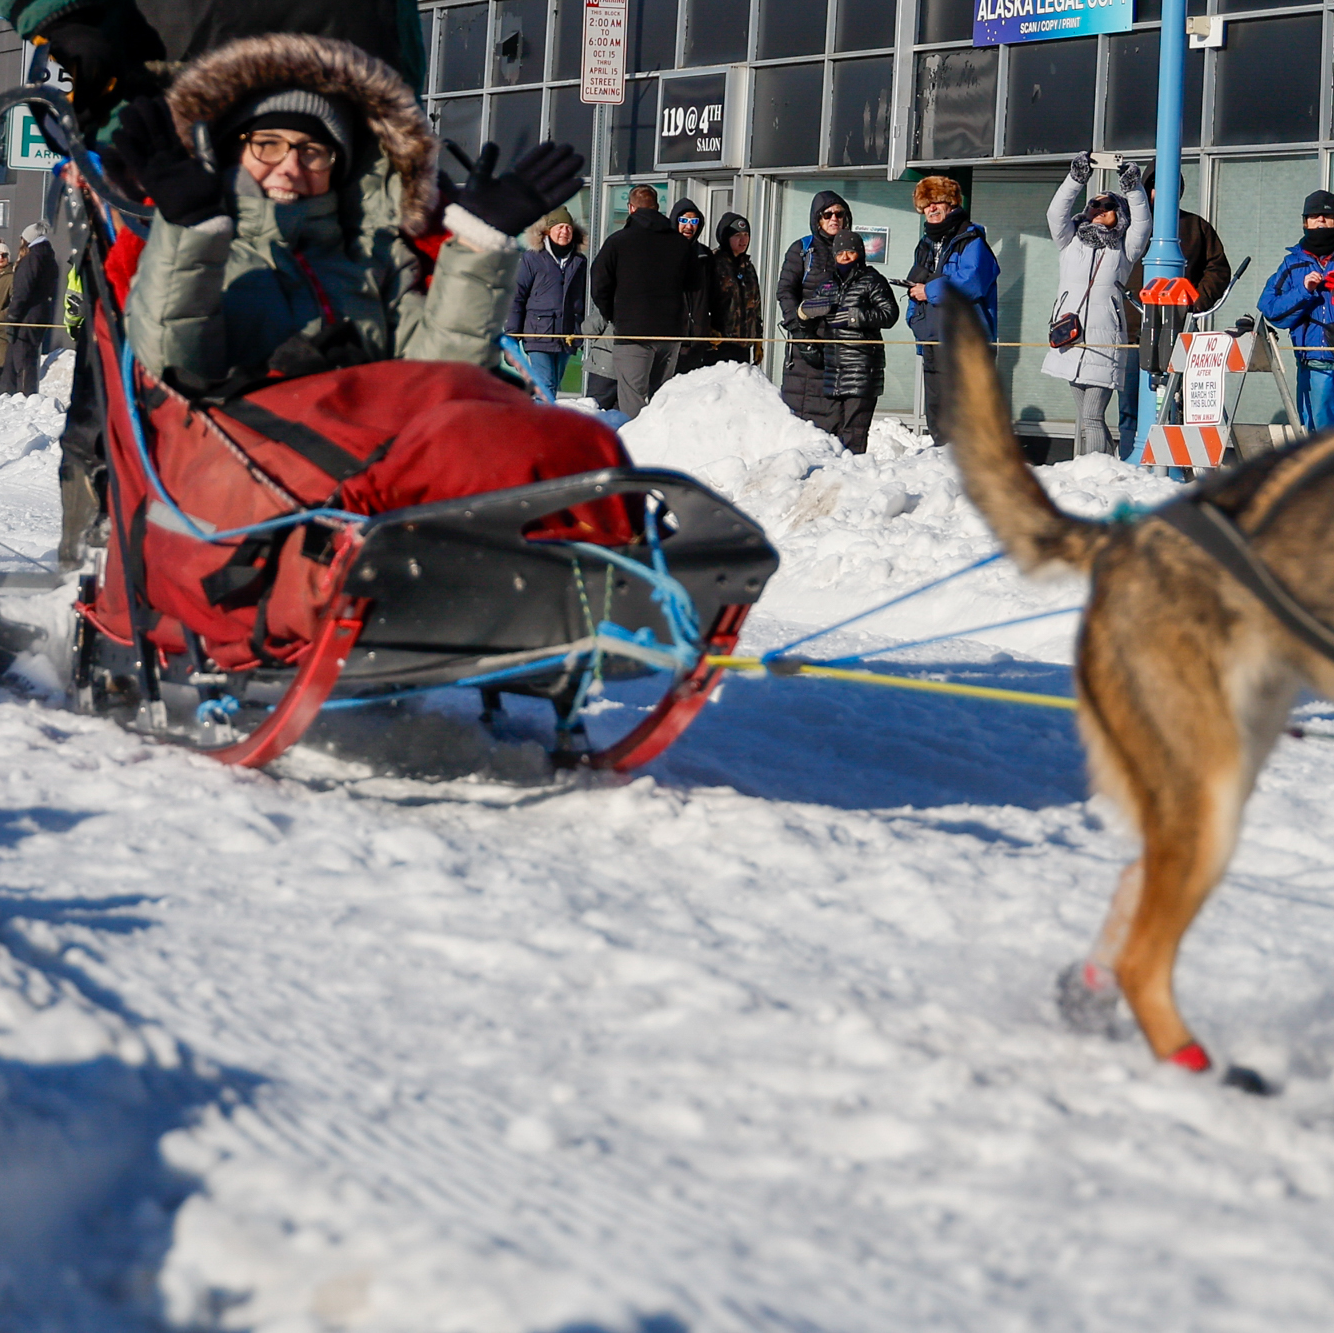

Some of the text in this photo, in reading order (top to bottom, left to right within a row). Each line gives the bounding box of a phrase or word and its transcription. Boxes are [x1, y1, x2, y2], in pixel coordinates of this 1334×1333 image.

[589, 17, 622, 28] 2:00 AM
[601, 28, 610, 36] TO
[589, 37, 621, 47] 6:00 AM
[593, 50, 615, 59] OCT 15
[589, 67, 608, 75] APRIL
[590, 78, 616, 86] STREET
[585, 87, 620, 96] CLEANING
[661, 106, 685, 137] 119
[699, 104, 722, 134] 4TH
[696, 137, 721, 152] SALON
[1205, 337, 1218, 352] NO
[1190, 352, 1223, 369] PARKING
[1196, 369, 1212, 377] AFTER
[1190, 381, 1217, 391] 3PM FRI
[1190, 391, 1216, 399] MARCH 1ST
[1190, 399, 1217, 408] THIS BLOCK
